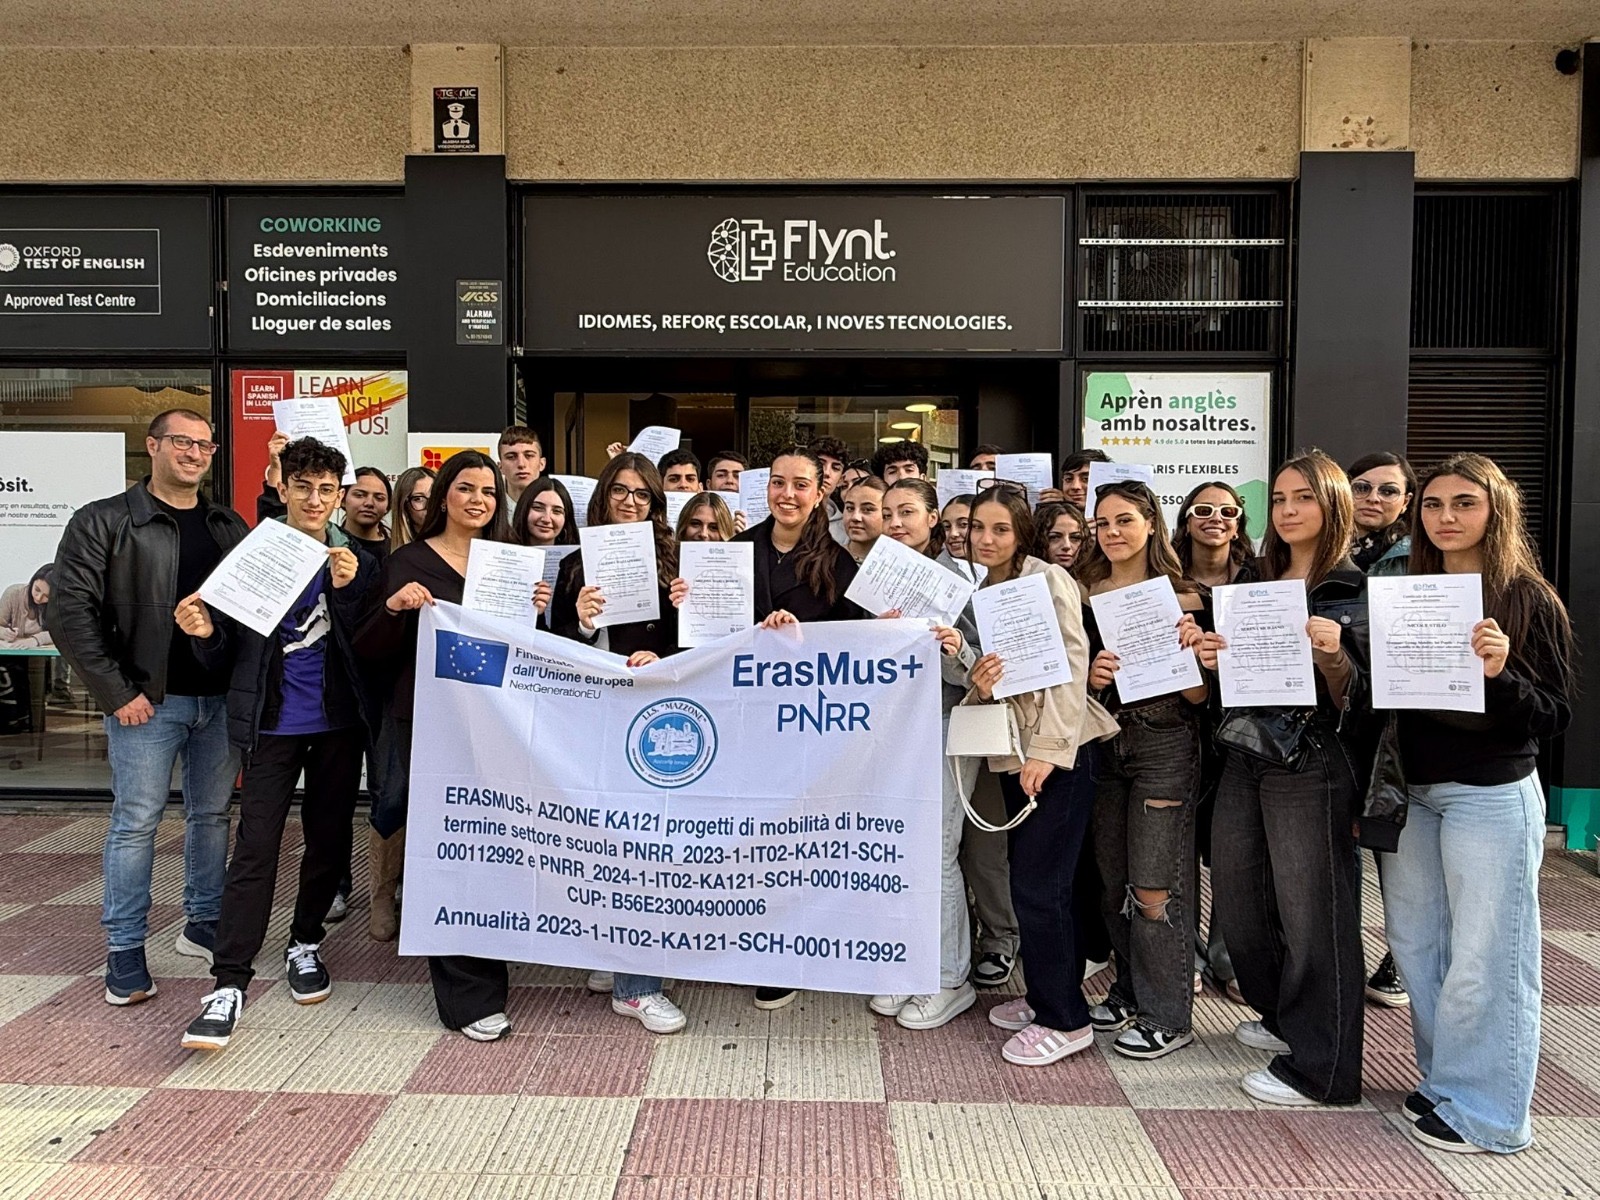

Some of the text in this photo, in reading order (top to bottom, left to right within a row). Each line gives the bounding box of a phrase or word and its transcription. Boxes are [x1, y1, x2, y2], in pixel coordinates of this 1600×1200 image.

[260, 217, 382, 232] COWORKING
[23, 246, 82, 257] OXFORD
[253, 242, 389, 258] Esdeveniments
[24, 258, 145, 269] TEST OF ENGLISH
[783, 261, 896, 282] Education
[244, 266, 398, 287] Oficines privades
[3, 293, 136, 309] Approved Test Centre
[256, 290, 387, 306] Domiciliacions
[466, 310, 493, 318] ALARMA
[251, 316, 392, 335] Lloguer de sales
[578, 314, 1013, 334] IDIOMES, REFORÇ ESCOLAR, I NOVES TECNOLOGIES.
[250, 384, 275, 392] LEARN
[298, 376, 364, 395] LEARN
[1100, 388, 1237, 413] Aprèn anglès
[358, 416, 389, 435] US!
[1100, 414, 1256, 431] amb nosaltres.
[1178, 464, 1239, 474] FLEXIBLES
[512, 663, 634, 688] dall'Unione europea
[732, 651, 923, 687] ErasMus+
[509, 679, 602, 700] NextGenerationEU
[777, 690, 871, 735] PNRR
[445, 786, 905, 838] ERASMUS+ AZIONE KA121 progetti di mobilità di breve
[444, 815, 904, 866] termine settore scuola PNRR_2023-1-IT02-KA121-SCH-
[437, 842, 524, 866] 000112992
[527, 855, 536, 867] e
[567, 886, 767, 916] CUP: B56E23004900006
[434, 906, 907, 962] Annualità 2023-1-IT02-KA121-SCH-000112992
